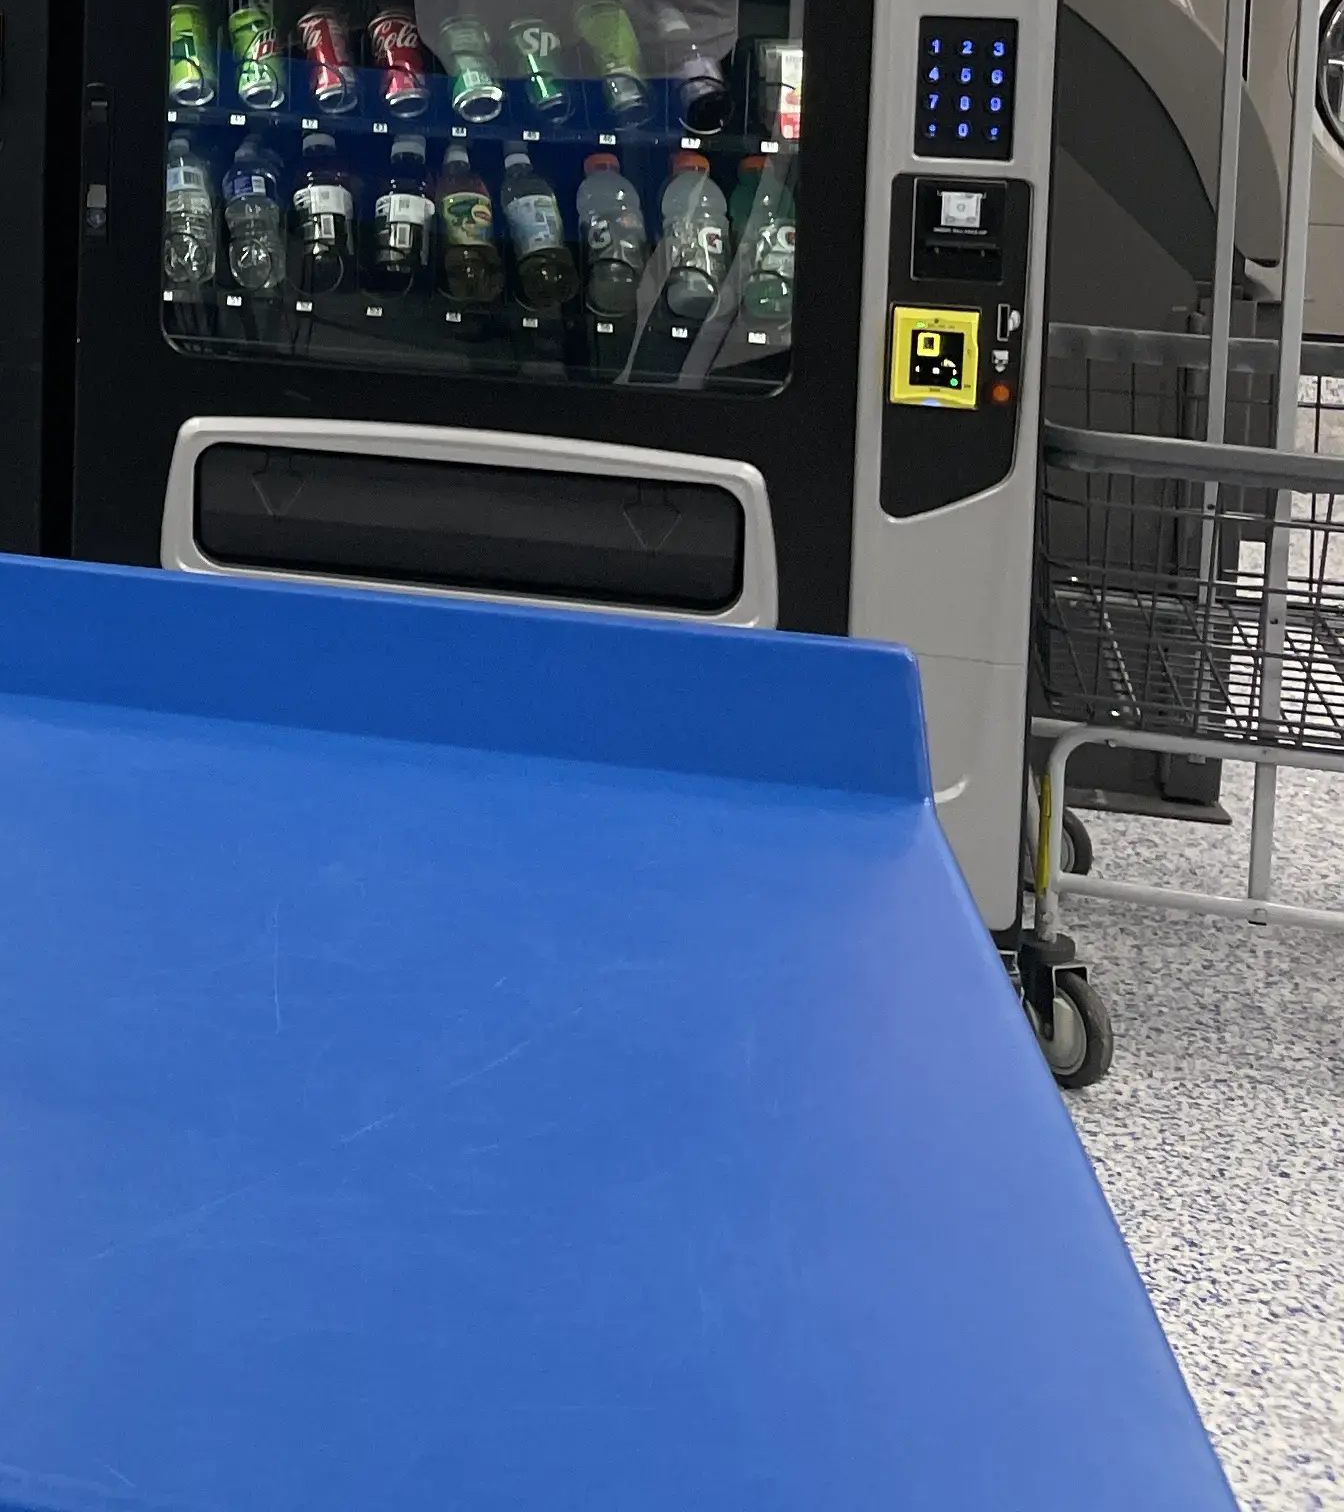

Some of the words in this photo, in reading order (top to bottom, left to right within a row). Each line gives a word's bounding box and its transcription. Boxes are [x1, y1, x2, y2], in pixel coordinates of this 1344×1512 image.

[932, 39, 939, 53] 1
[962, 40, 972, 54] 2
[993, 41, 1005, 57] 3
[929, 67, 940, 81] 4
[929, 94, 939, 109] 7
[958, 123, 969, 137] 0
